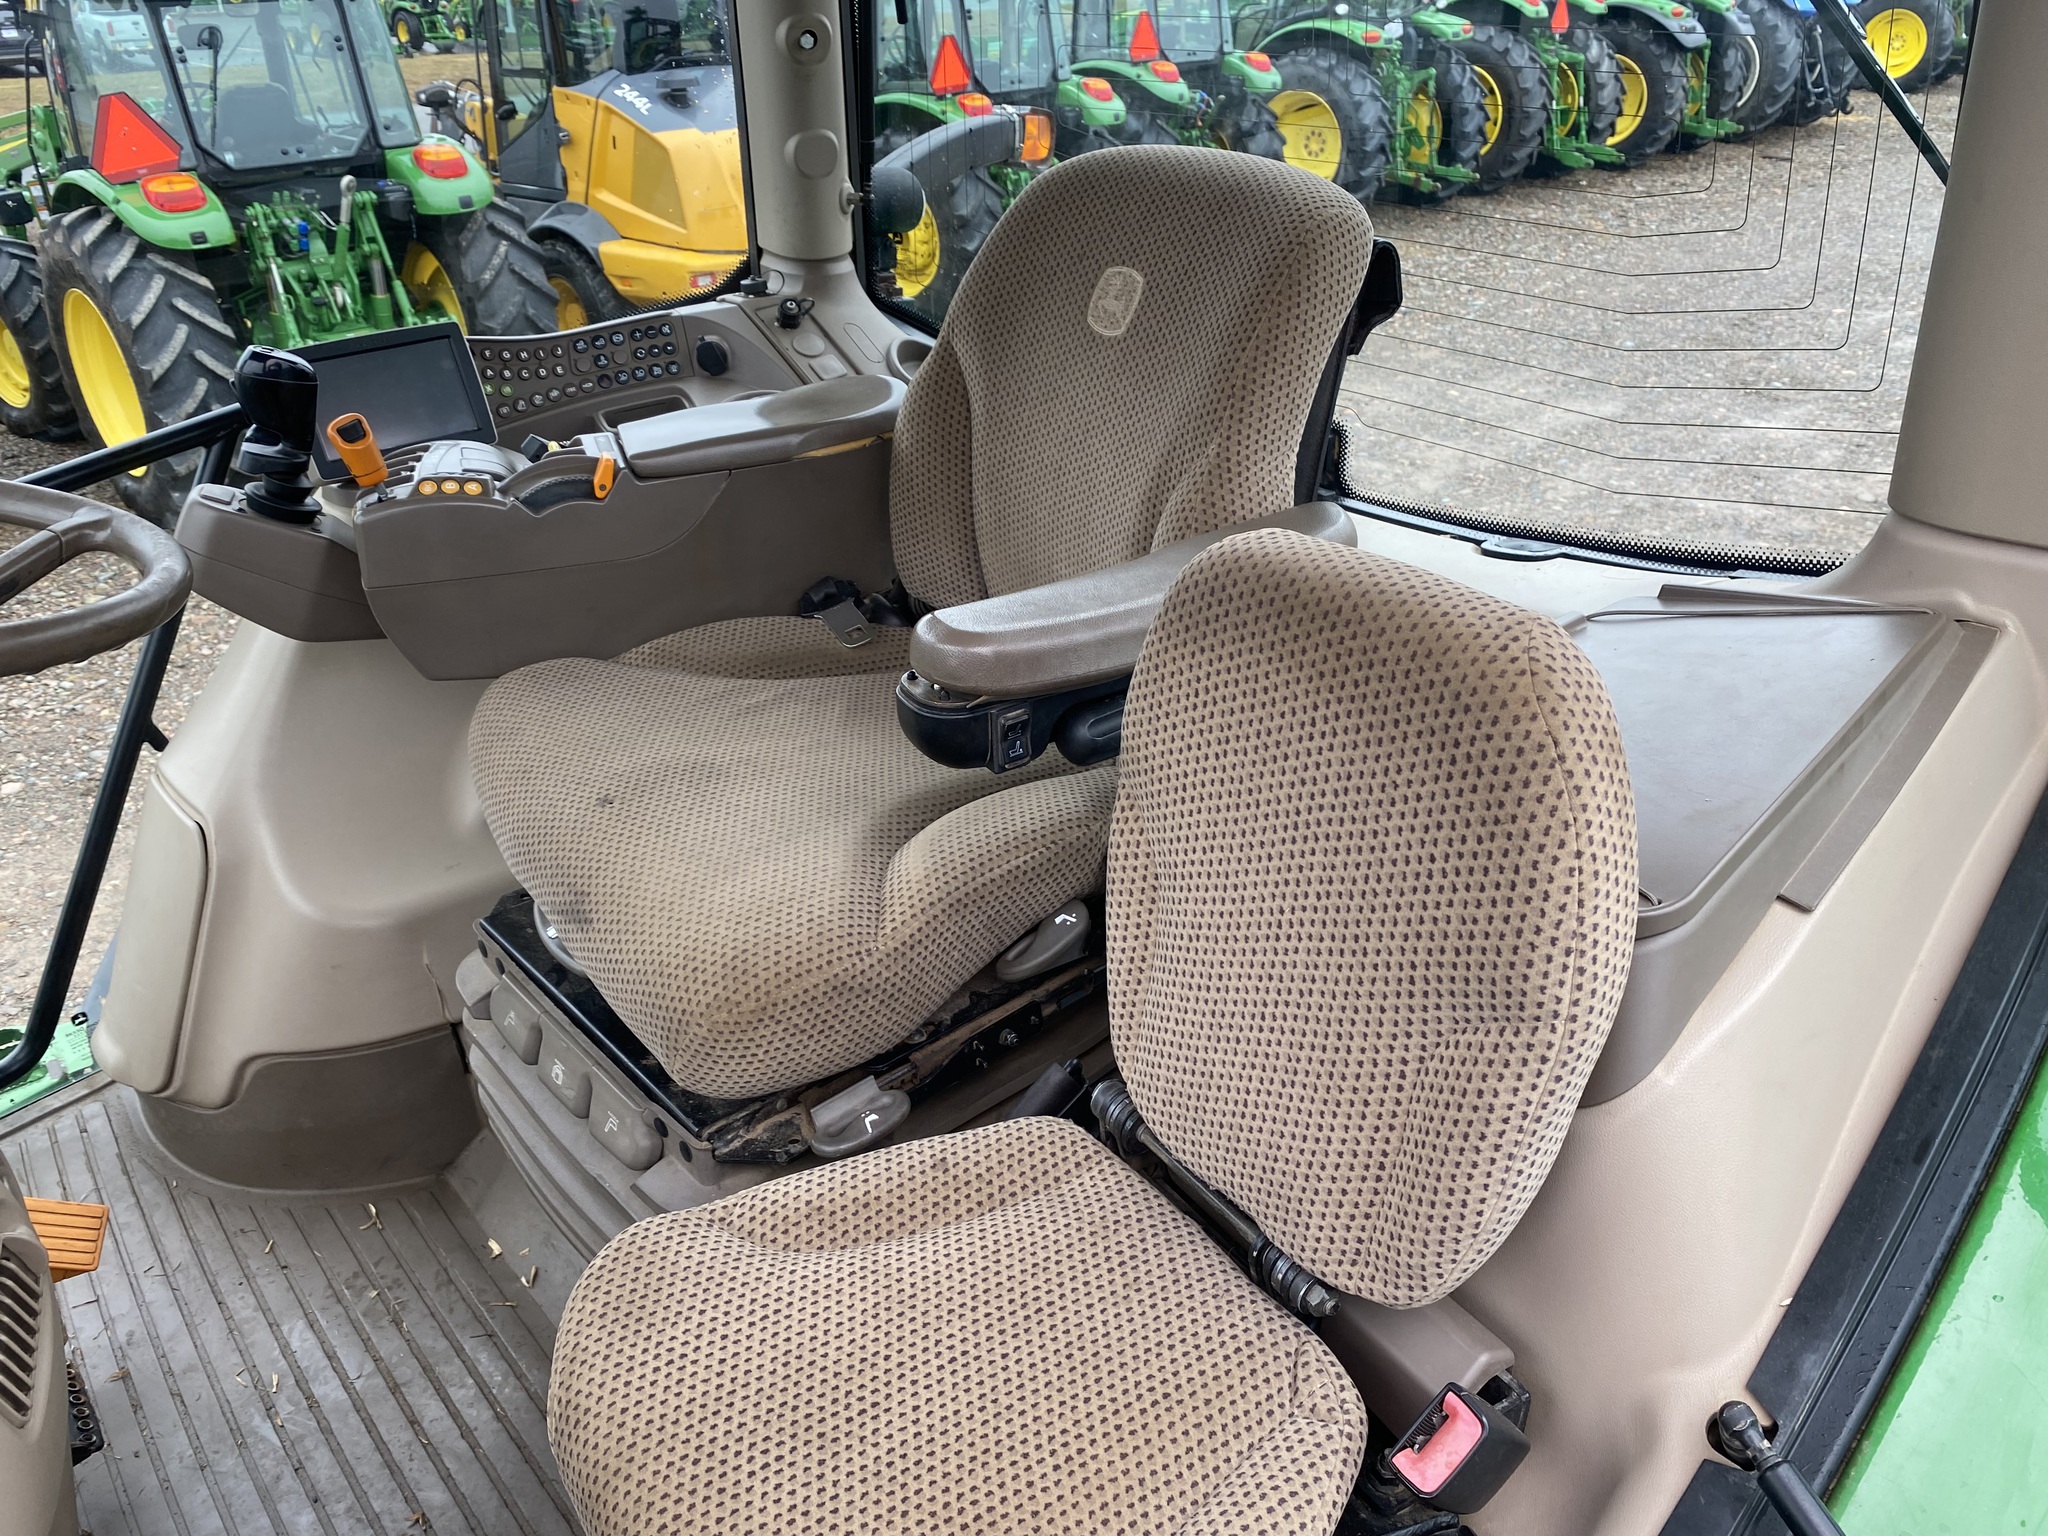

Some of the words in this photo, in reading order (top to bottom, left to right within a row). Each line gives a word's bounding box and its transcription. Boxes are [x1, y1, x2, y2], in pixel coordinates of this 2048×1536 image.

[613, 83, 652, 115] 244L
[520, 351, 528, 359] H
[556, 347, 562, 355] J
[486, 369, 494, 377] A
[539, 368, 547, 376] D
[556, 366, 564, 374] E
